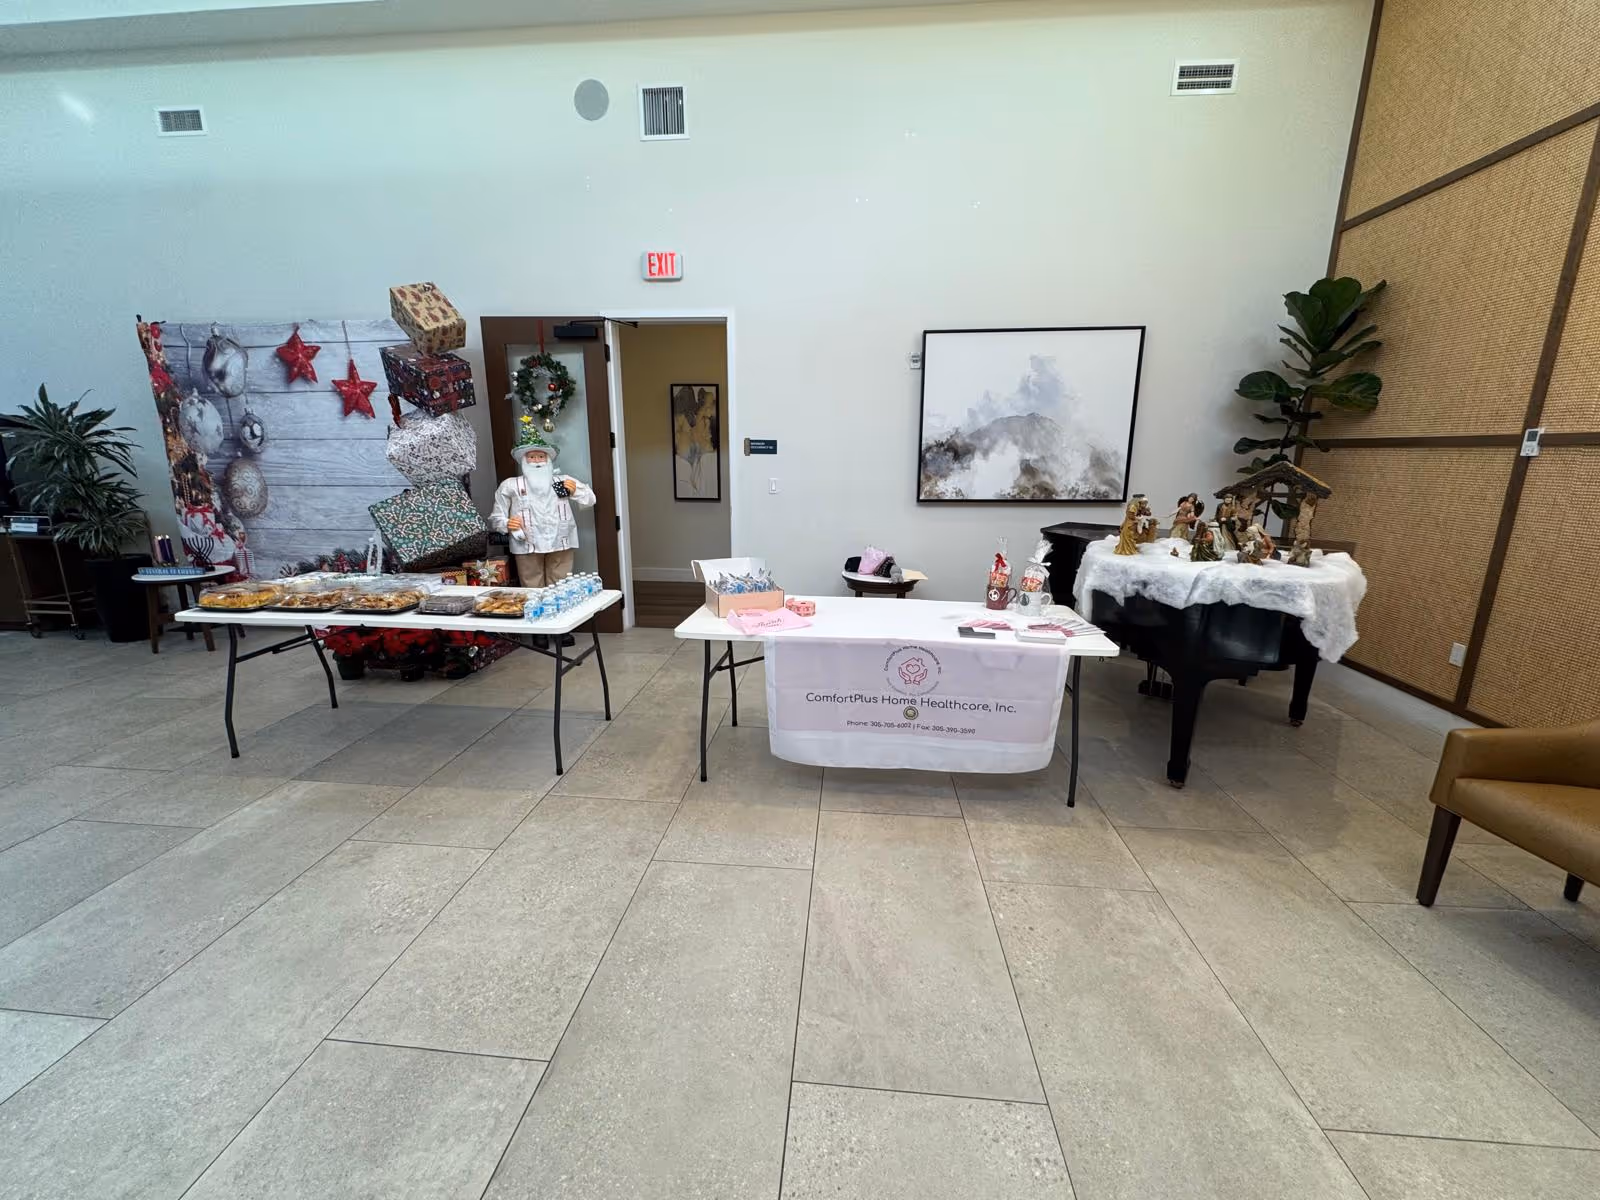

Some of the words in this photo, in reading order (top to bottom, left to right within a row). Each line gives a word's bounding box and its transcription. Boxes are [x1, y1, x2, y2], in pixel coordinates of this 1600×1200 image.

[648, 252, 676, 276] EXIT
[806, 692, 878, 704] ComfortPlus
[881, 695, 917, 706] Home
[920, 697, 992, 713] Healthcare,
[995, 702, 1017, 713] Inc.
[931, 725, 976, 735] 305-390-3590
